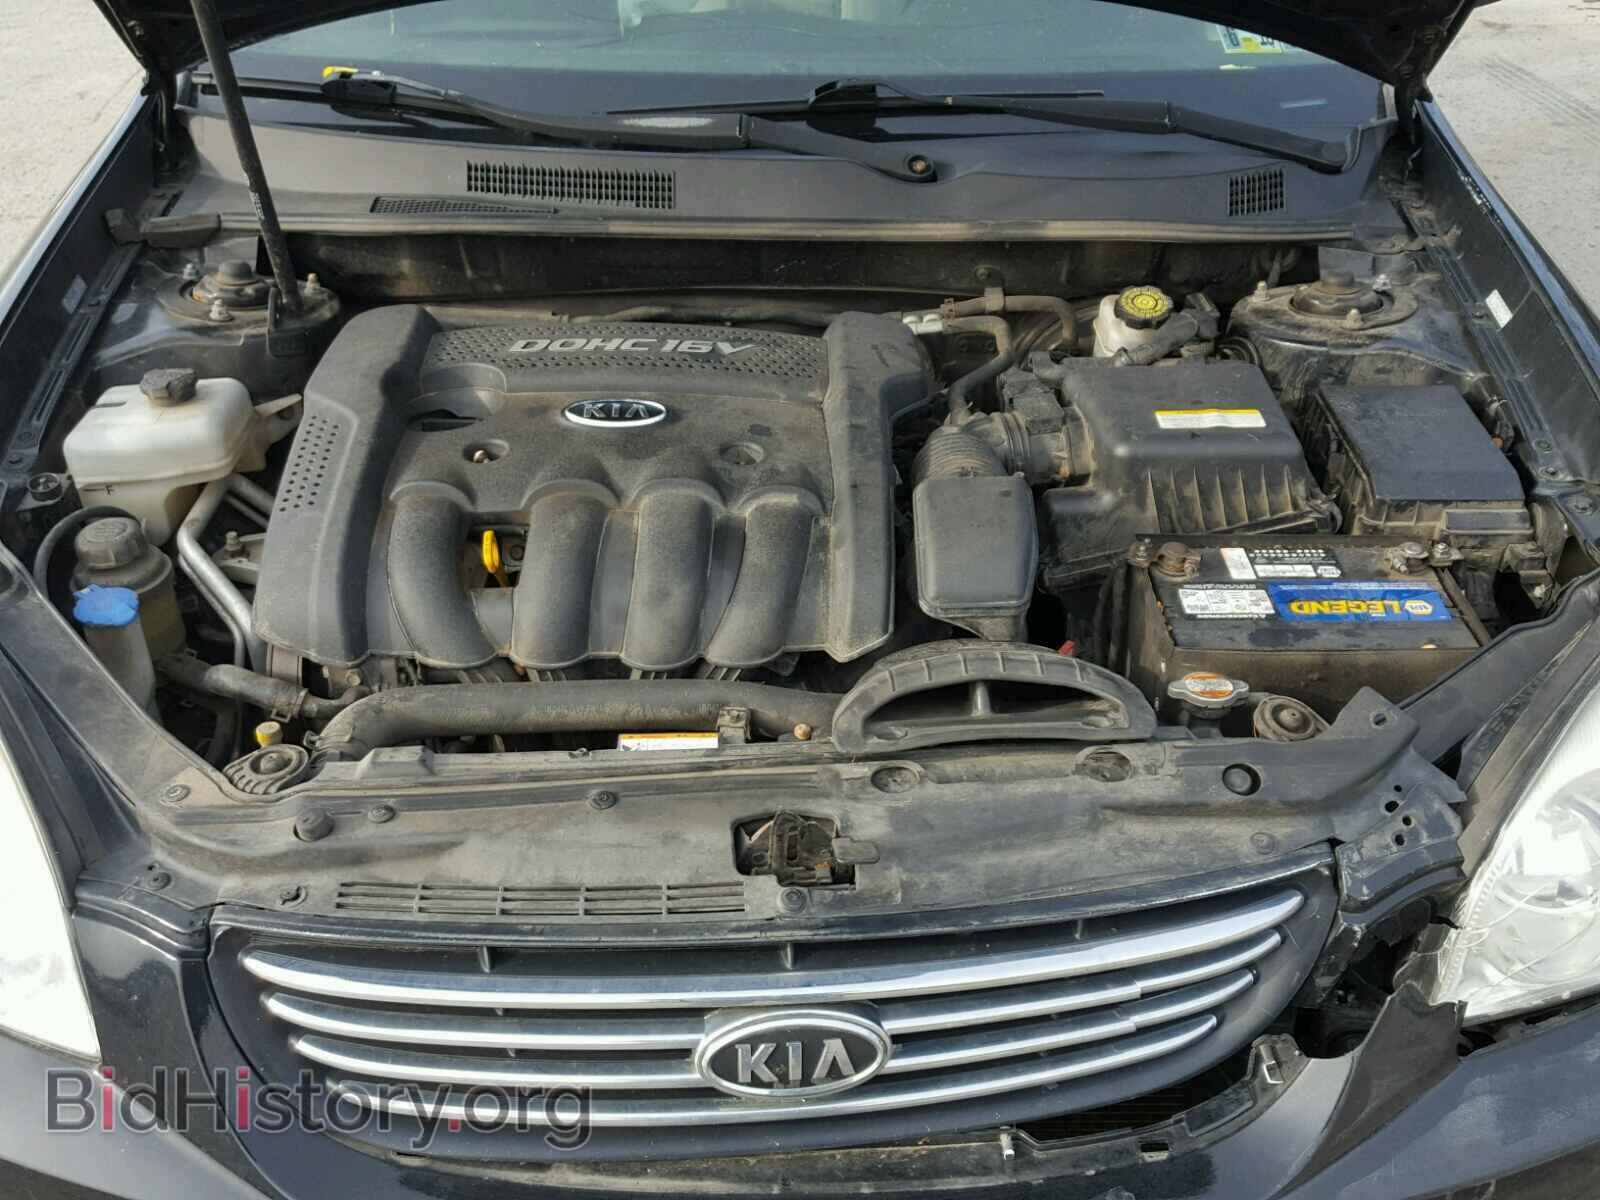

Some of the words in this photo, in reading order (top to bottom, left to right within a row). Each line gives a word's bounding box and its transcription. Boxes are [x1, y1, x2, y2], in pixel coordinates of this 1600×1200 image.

[509, 338, 658, 351] DOHC
[661, 338, 754, 354] 16V
[583, 403, 650, 418] KIA
[1289, 599, 1402, 616] LEGEND
[735, 1038, 856, 1085] KIA
